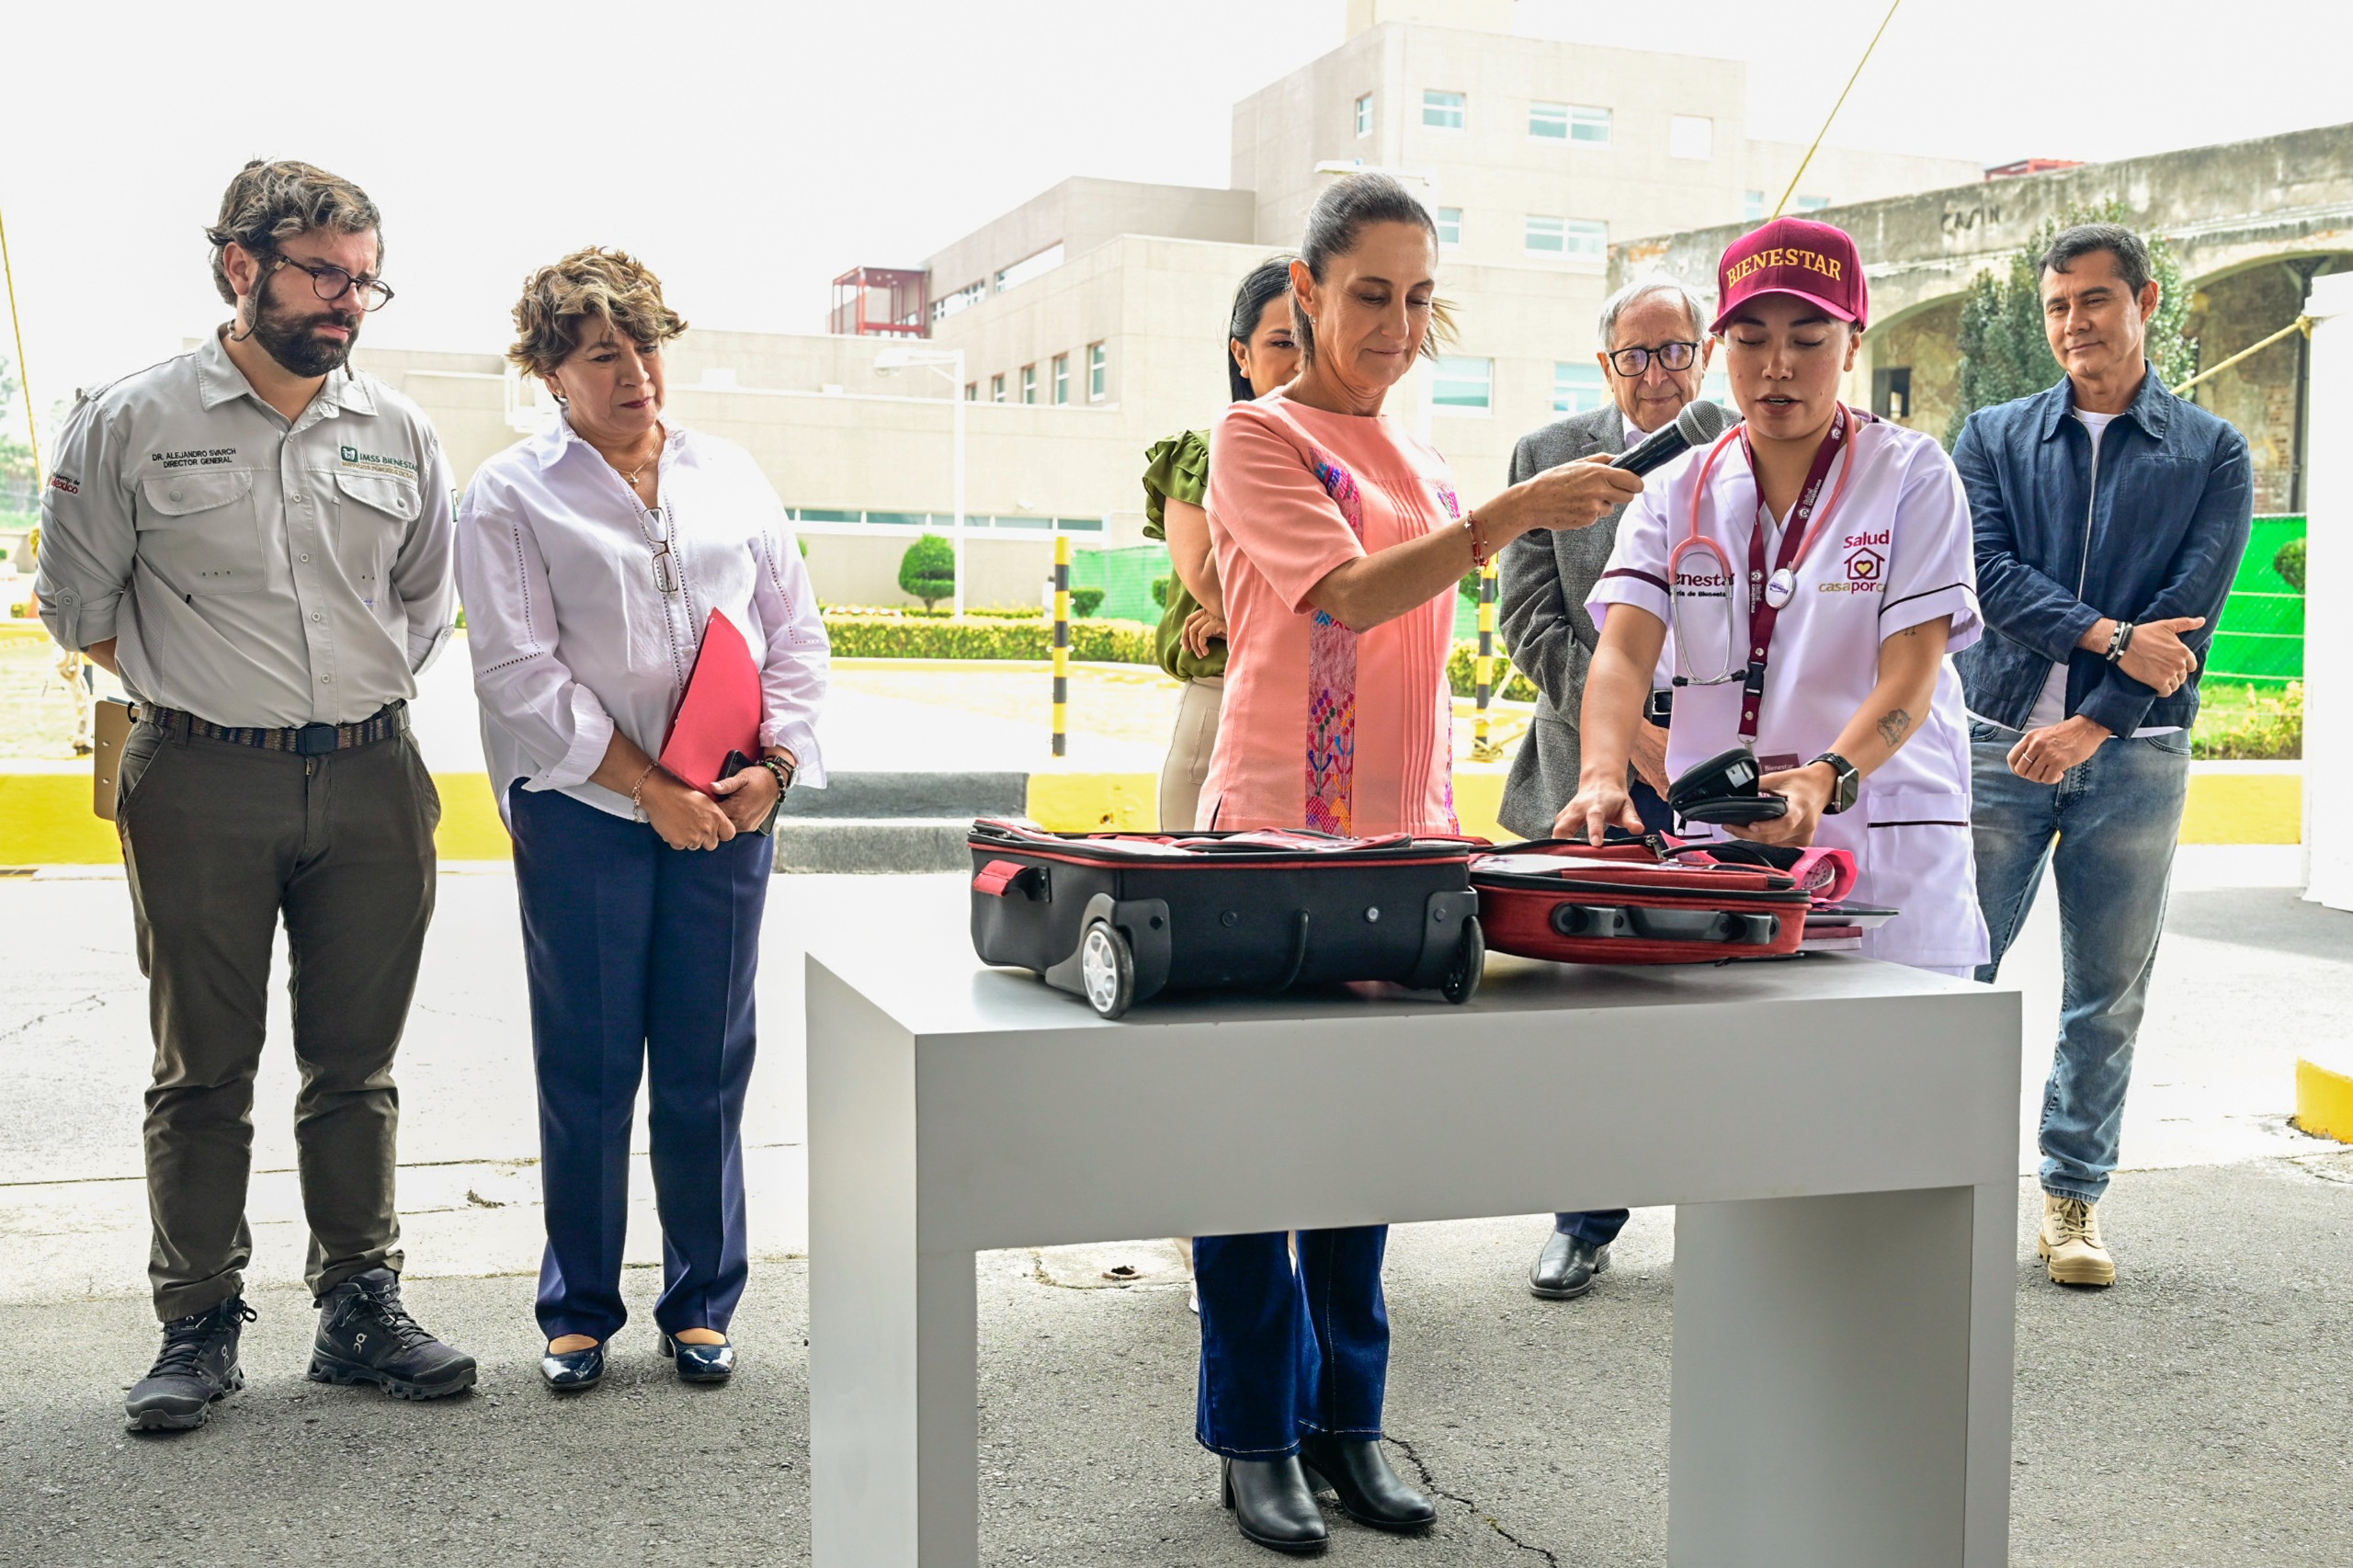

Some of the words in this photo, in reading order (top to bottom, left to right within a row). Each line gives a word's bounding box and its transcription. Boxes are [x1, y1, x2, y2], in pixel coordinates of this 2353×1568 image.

[1726, 248, 1842, 290] BIENESTAR
[152, 453, 164, 461] DR.
[166, 450, 208, 460] ALEJANDRO
[209, 448, 236, 457] SVARCH
[359, 453, 380, 462] IMSS
[164, 460, 198, 469] DIRECTOR
[200, 457, 233, 465] GENERAL
[1843, 529, 1890, 549] Salud
[1698, 590, 1727, 598] Bienesta
[1764, 764, 1794, 772] Bienestar
